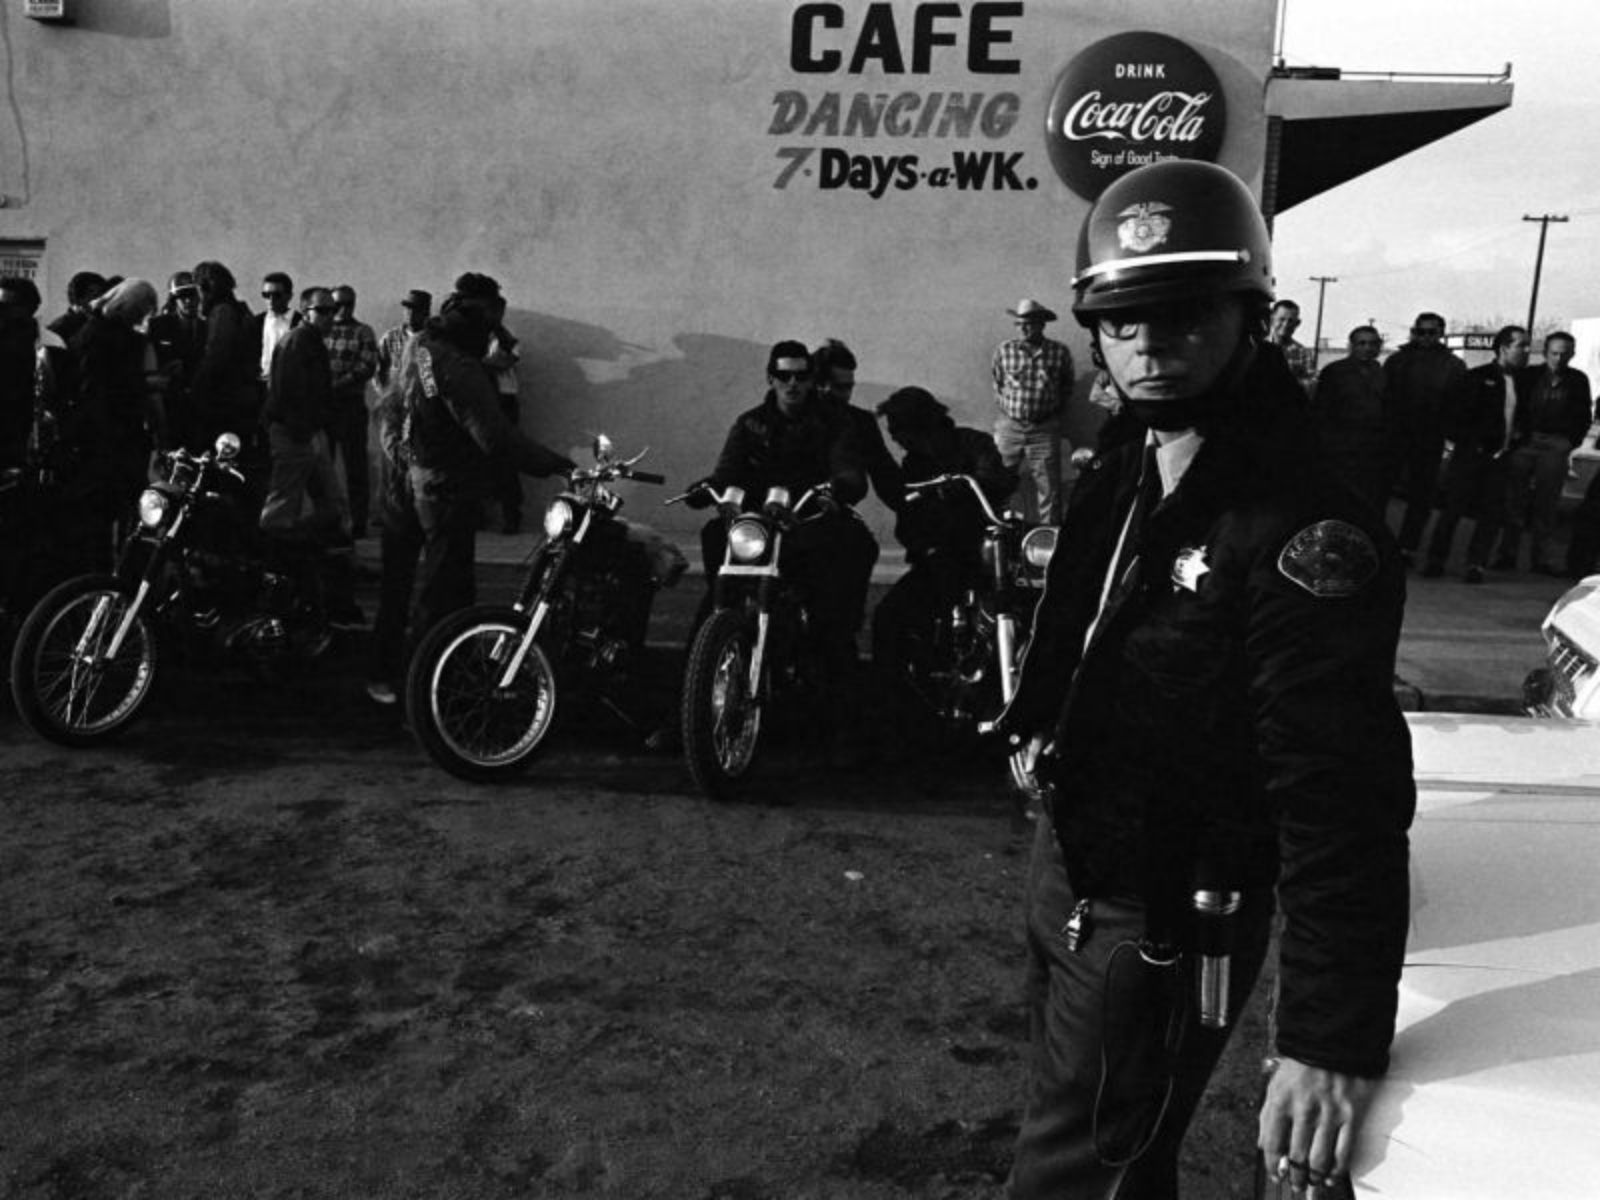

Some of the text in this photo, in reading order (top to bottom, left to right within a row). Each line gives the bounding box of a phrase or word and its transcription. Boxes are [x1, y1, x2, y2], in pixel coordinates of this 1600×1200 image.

[791, 2, 1024, 74] CAFE
[1115, 64, 1165, 78] DRINK
[768, 90, 1020, 139] DANCING
[1091, 150, 1112, 168] Sign
[1114, 152, 1125, 165] of
[1127, 150, 1152, 165] Good
